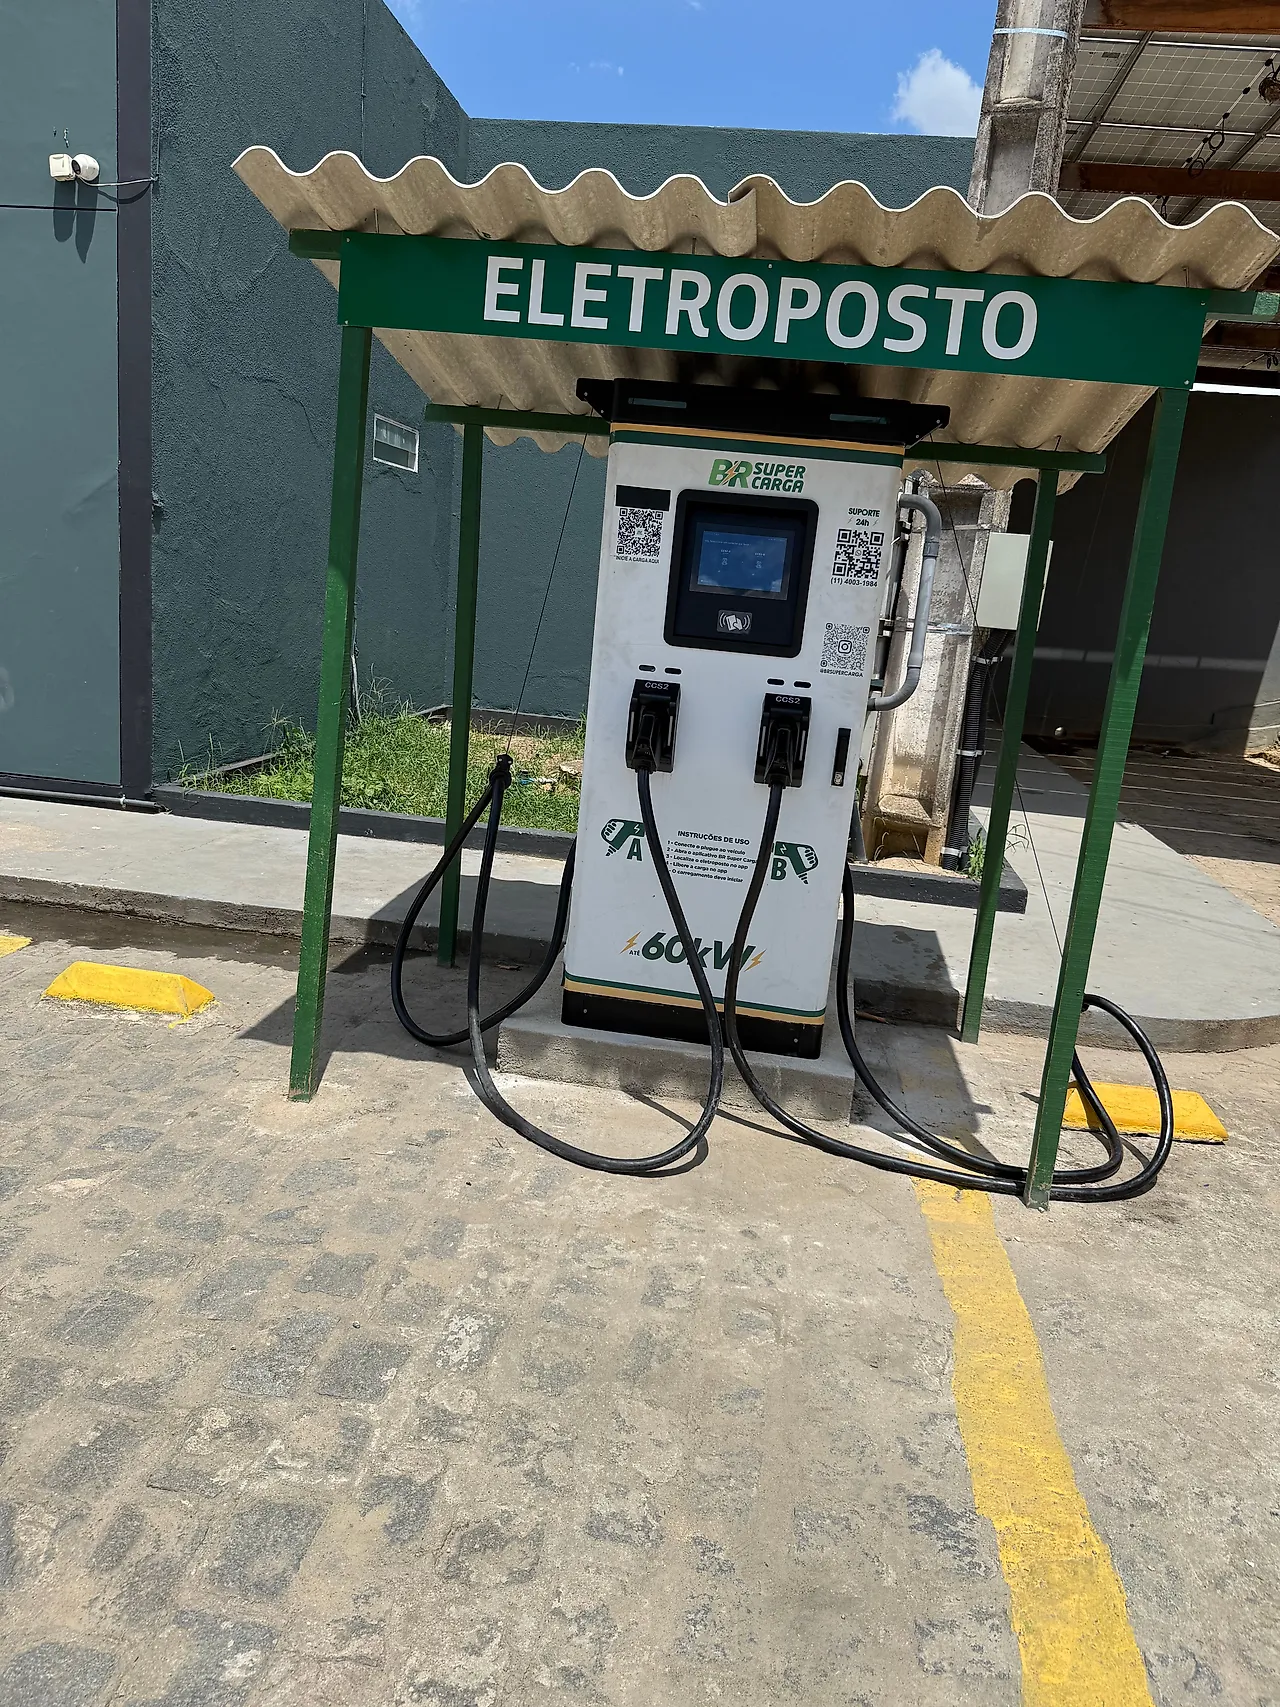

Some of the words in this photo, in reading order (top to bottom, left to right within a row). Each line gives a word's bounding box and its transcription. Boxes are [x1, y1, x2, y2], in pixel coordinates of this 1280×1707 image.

[483, 256, 1038, 360] ELETROPOSTO
[708, 458, 752, 488] BR
[753, 462, 806, 479] SUPER
[751, 476, 804, 493] CARGA
[848, 507, 881, 517] SUPORTE
[855, 518, 870, 527] 24h
[830, 577, 843, 586] (11)
[844, 578, 878, 588] 4003-1984
[645, 681, 669, 690] CCS2
[775, 695, 801, 704] CCS2
[677, 830, 722, 842] INSTRUÇÕES
[723, 836, 733, 844] DE
[626, 837, 643, 862] A
[770, 857, 787, 881] B
